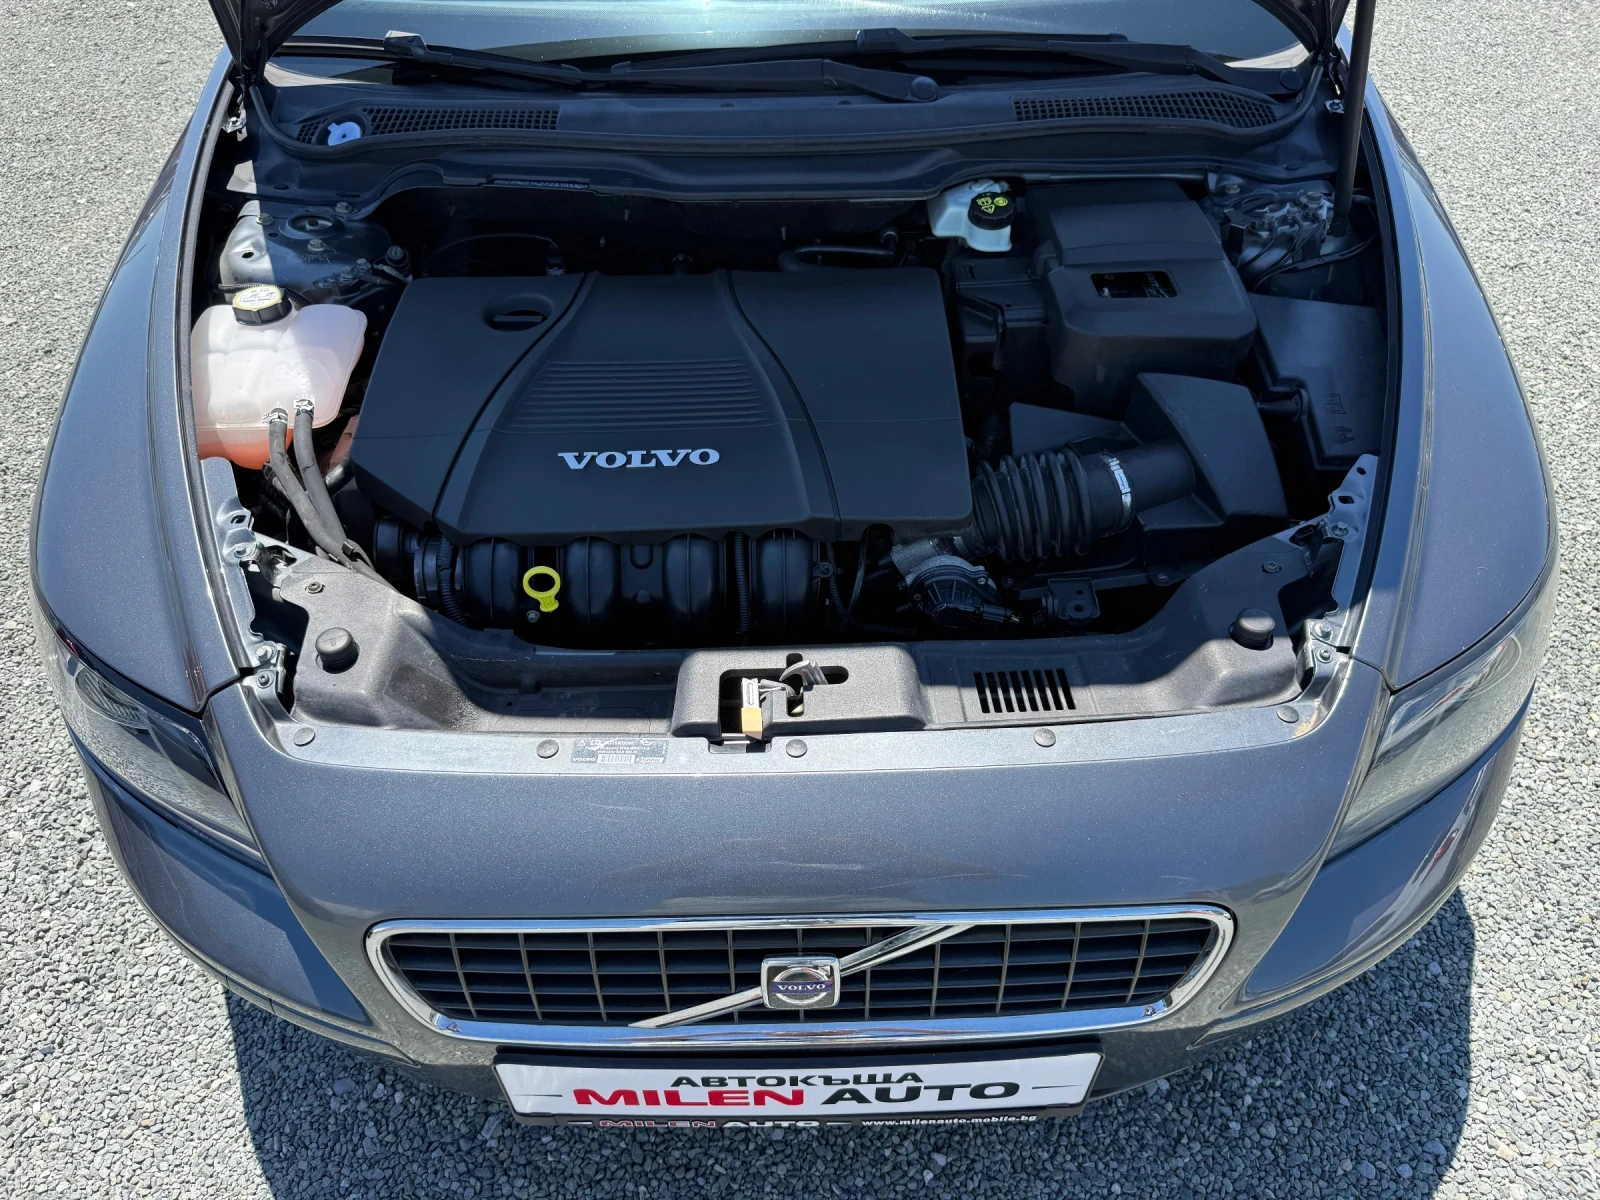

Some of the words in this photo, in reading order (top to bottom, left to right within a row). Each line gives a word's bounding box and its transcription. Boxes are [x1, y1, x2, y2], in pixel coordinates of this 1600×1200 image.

[558, 448, 720, 470] VOLVO
[777, 983, 826, 991] VOLVO
[573, 1088, 804, 1106] MILEN
[820, 1082, 1020, 1105] AUTO
[600, 1120, 716, 1128] MILEN
[722, 1120, 820, 1128] AUTO
